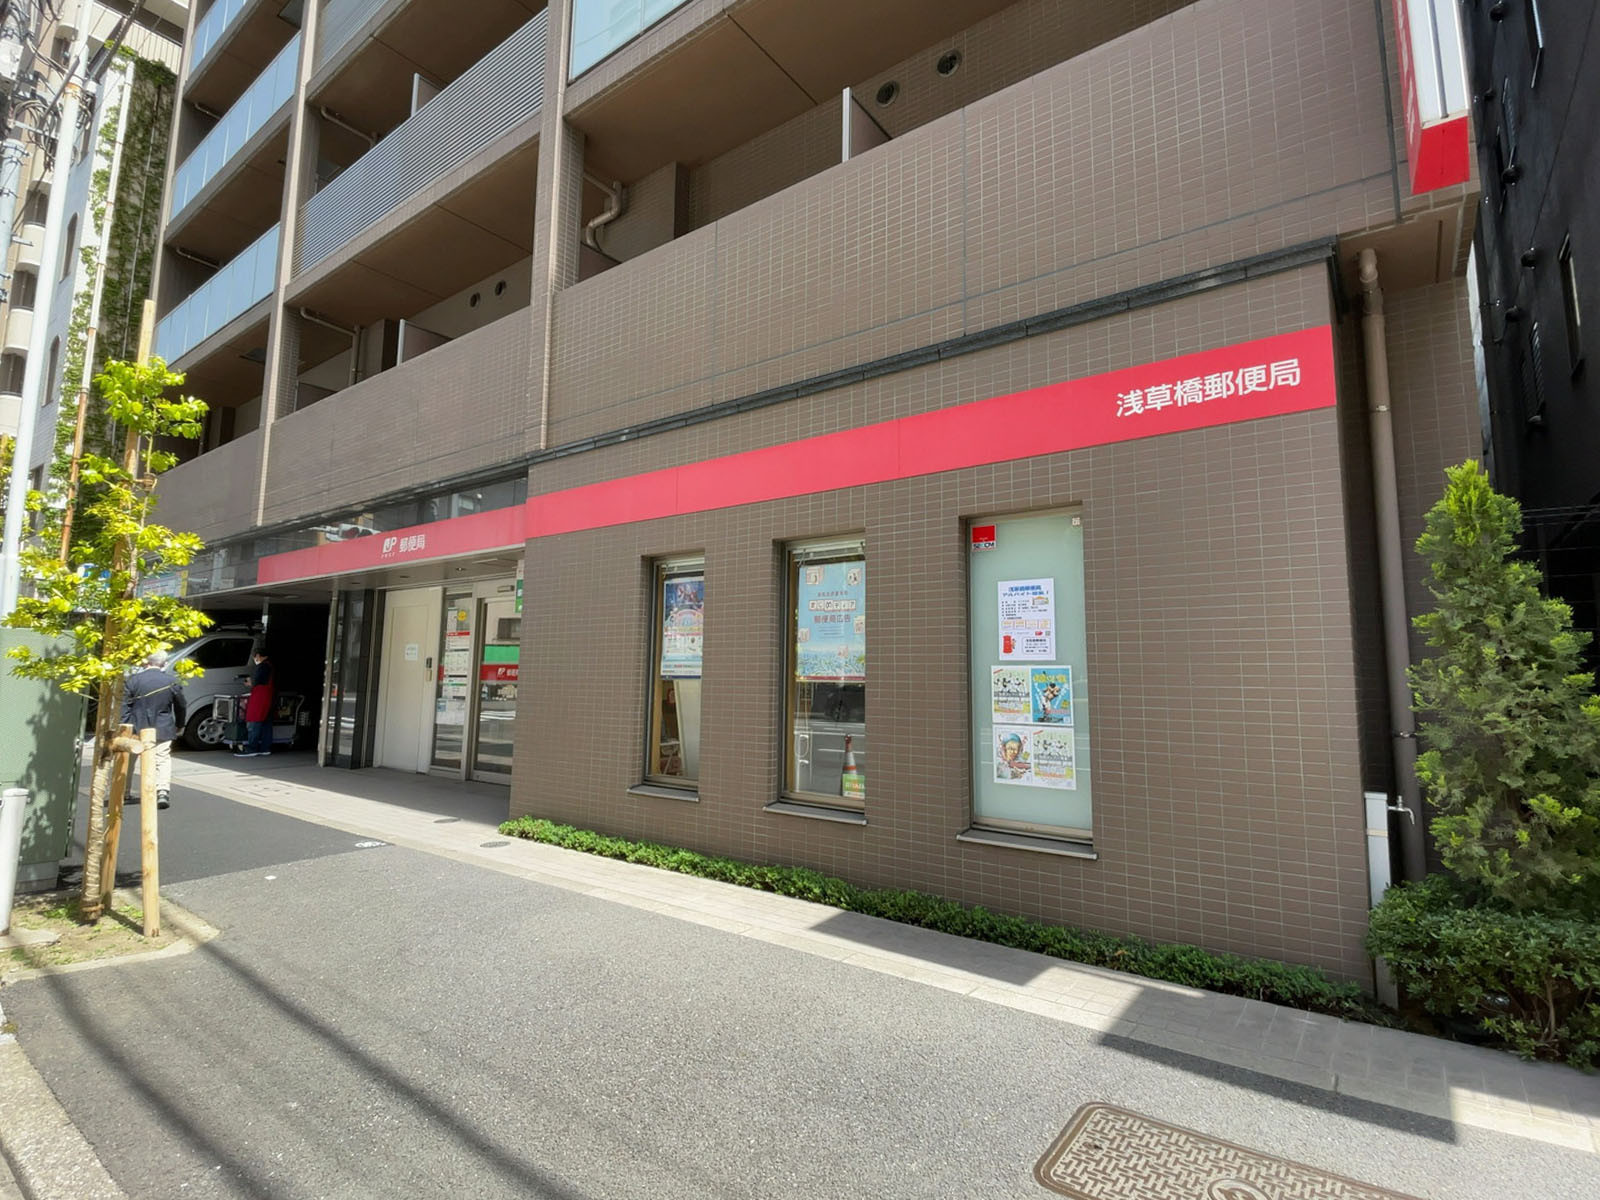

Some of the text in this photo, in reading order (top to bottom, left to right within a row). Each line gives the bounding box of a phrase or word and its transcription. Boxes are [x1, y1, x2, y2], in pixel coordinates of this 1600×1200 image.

[1116, 358, 1301, 418] 浅草橋郵便局
[399, 534, 425, 553] 郵便局
